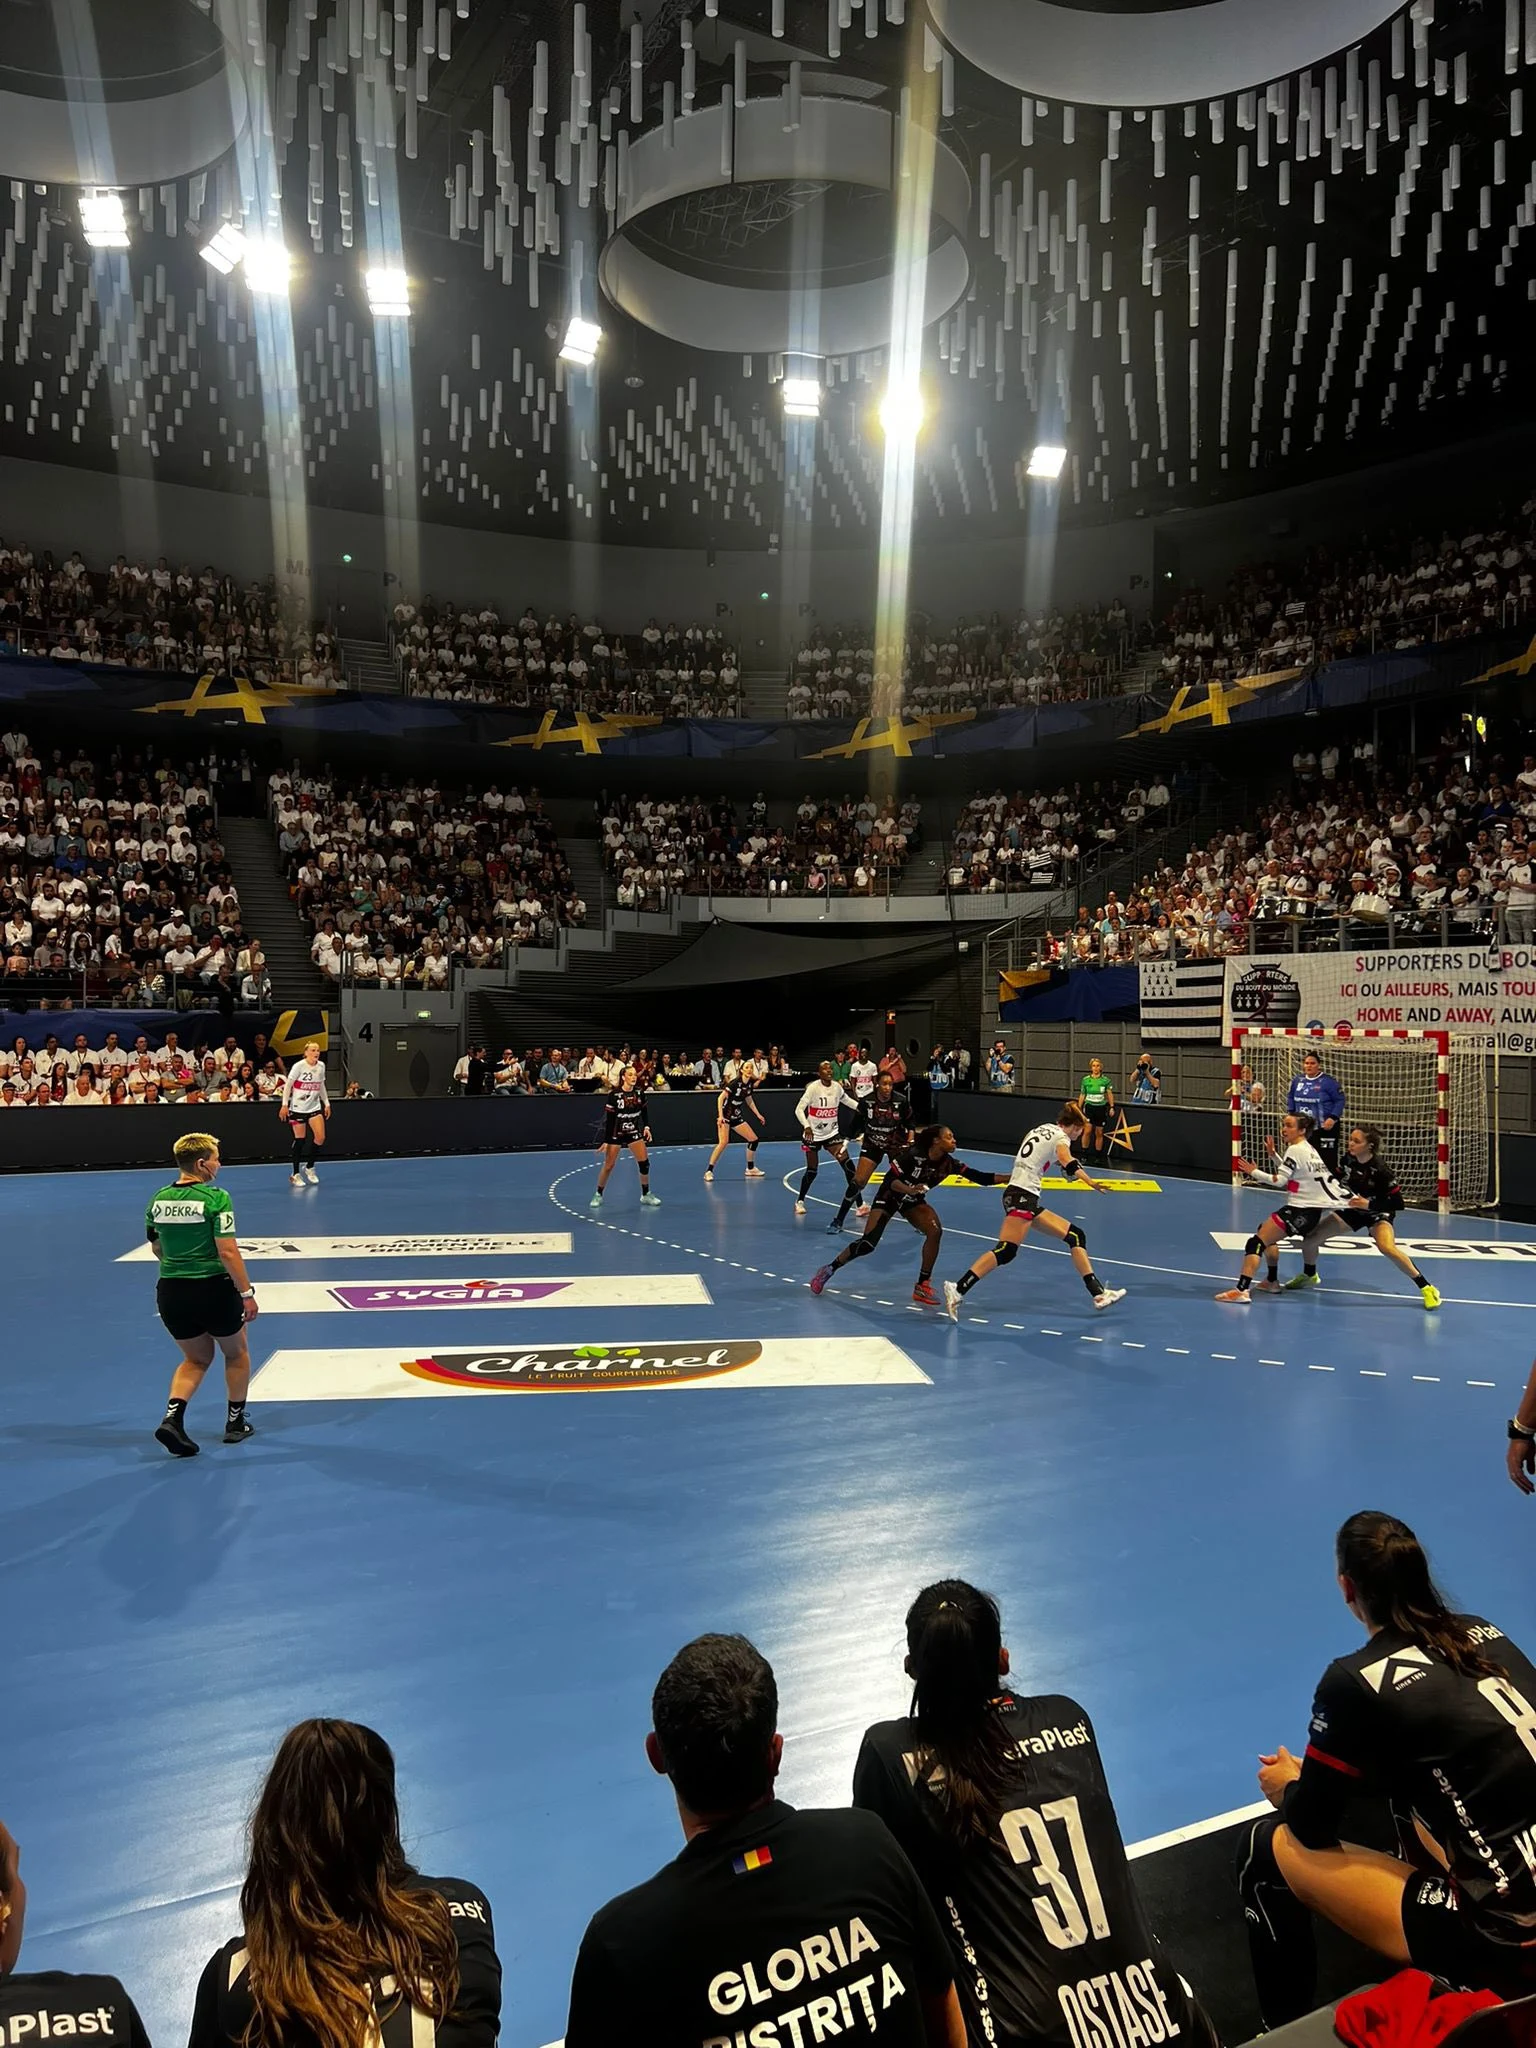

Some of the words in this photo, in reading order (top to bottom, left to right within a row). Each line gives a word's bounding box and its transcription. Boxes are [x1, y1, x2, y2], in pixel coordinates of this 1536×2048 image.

[1355, 953, 1462, 972] SUPPORTERS
[1502, 951, 1529, 969] BO
[1243, 970, 1289, 984] SUPPRTERS
[1341, 984, 1357, 997] ICI
[1361, 984, 1381, 997] OU
[1384, 982, 1453, 998] AILLEURS,
[1458, 982, 1498, 996] MAIS
[1502, 981, 1536, 996] TOU
[1357, 1008, 1403, 1022] HOME
[1407, 1008, 1441, 1022] AND
[1445, 1008, 1496, 1026] AWAY,
[1501, 1008, 1536, 1023] ALW
[358, 1022, 373, 1043] 4
[302, 1072, 313, 1081] 23
[819, 1097, 828, 1107] 11
[815, 1108, 838, 1117] BRES
[1021, 1136, 1040, 1158] 6
[1314, 1175, 1354, 1201] 13
[164, 1206, 201, 1217] DEKRA
[366, 1288, 524, 1301] SYGIA
[465, 1348, 731, 1374] Charnel
[550, 1371, 584, 1380] FRUIT
[593, 1368, 680, 1379] GOURMANDISE
[998, 1704, 1018, 1714] ANIA
[1432, 1767, 1475, 1828] Service
[1468, 1828, 1493, 1859] Car
[998, 1795, 1111, 1950] 37
[707, 1916, 881, 2016] GLORIA
[1058, 1958, 1180, 2048] OSTASE
